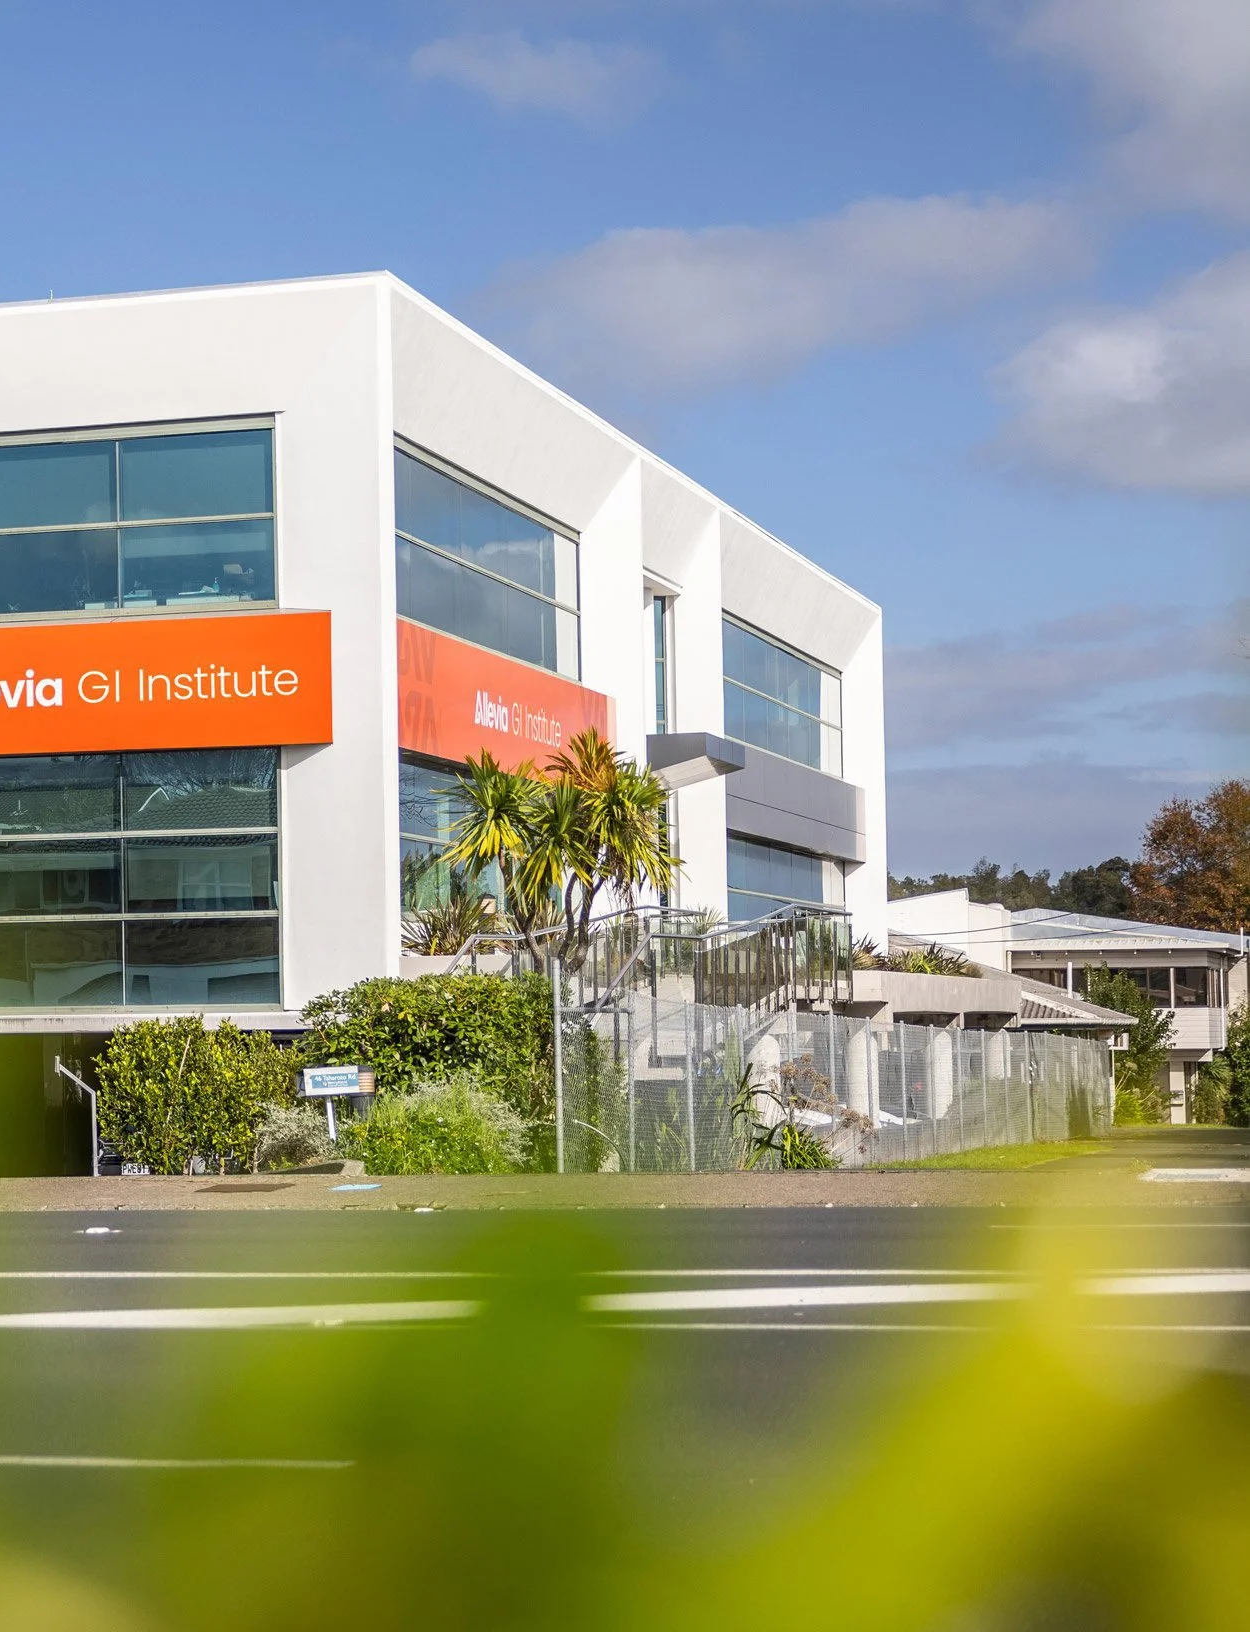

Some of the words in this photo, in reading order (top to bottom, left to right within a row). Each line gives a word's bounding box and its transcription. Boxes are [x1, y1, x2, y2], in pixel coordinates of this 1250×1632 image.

[78, 670, 120, 704] GI
[139, 663, 299, 702] Institute
[474, 689, 509, 733] Allevia
[511, 702, 523, 737] GI
[525, 705, 562, 748] Institute
